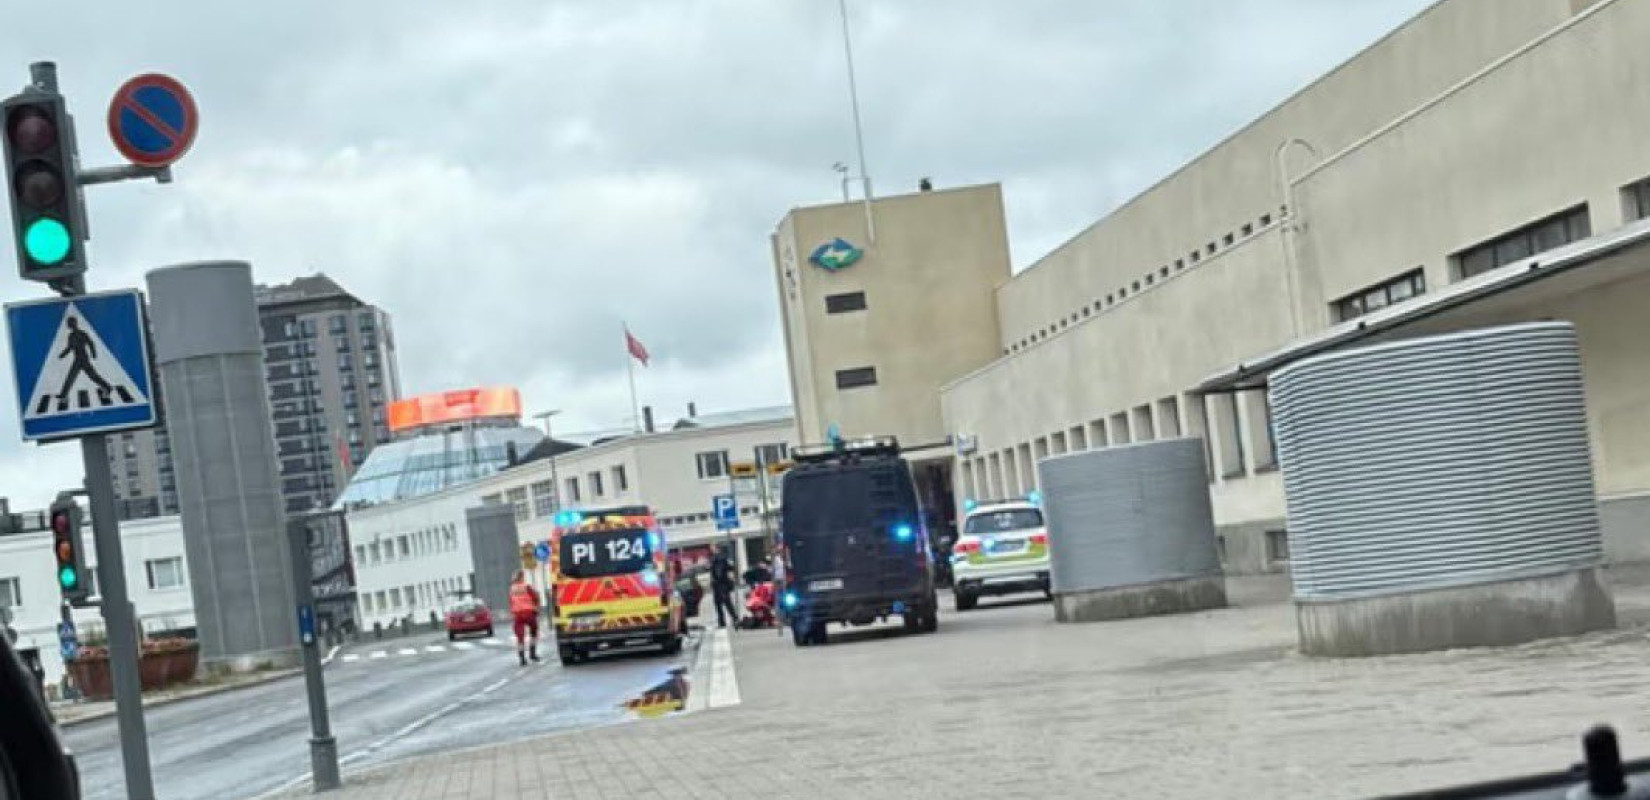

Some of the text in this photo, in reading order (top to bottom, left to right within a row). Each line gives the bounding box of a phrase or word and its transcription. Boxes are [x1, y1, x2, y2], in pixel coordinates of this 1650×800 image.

[717, 498, 734, 520] P
[572, 538, 645, 565] PI 124
